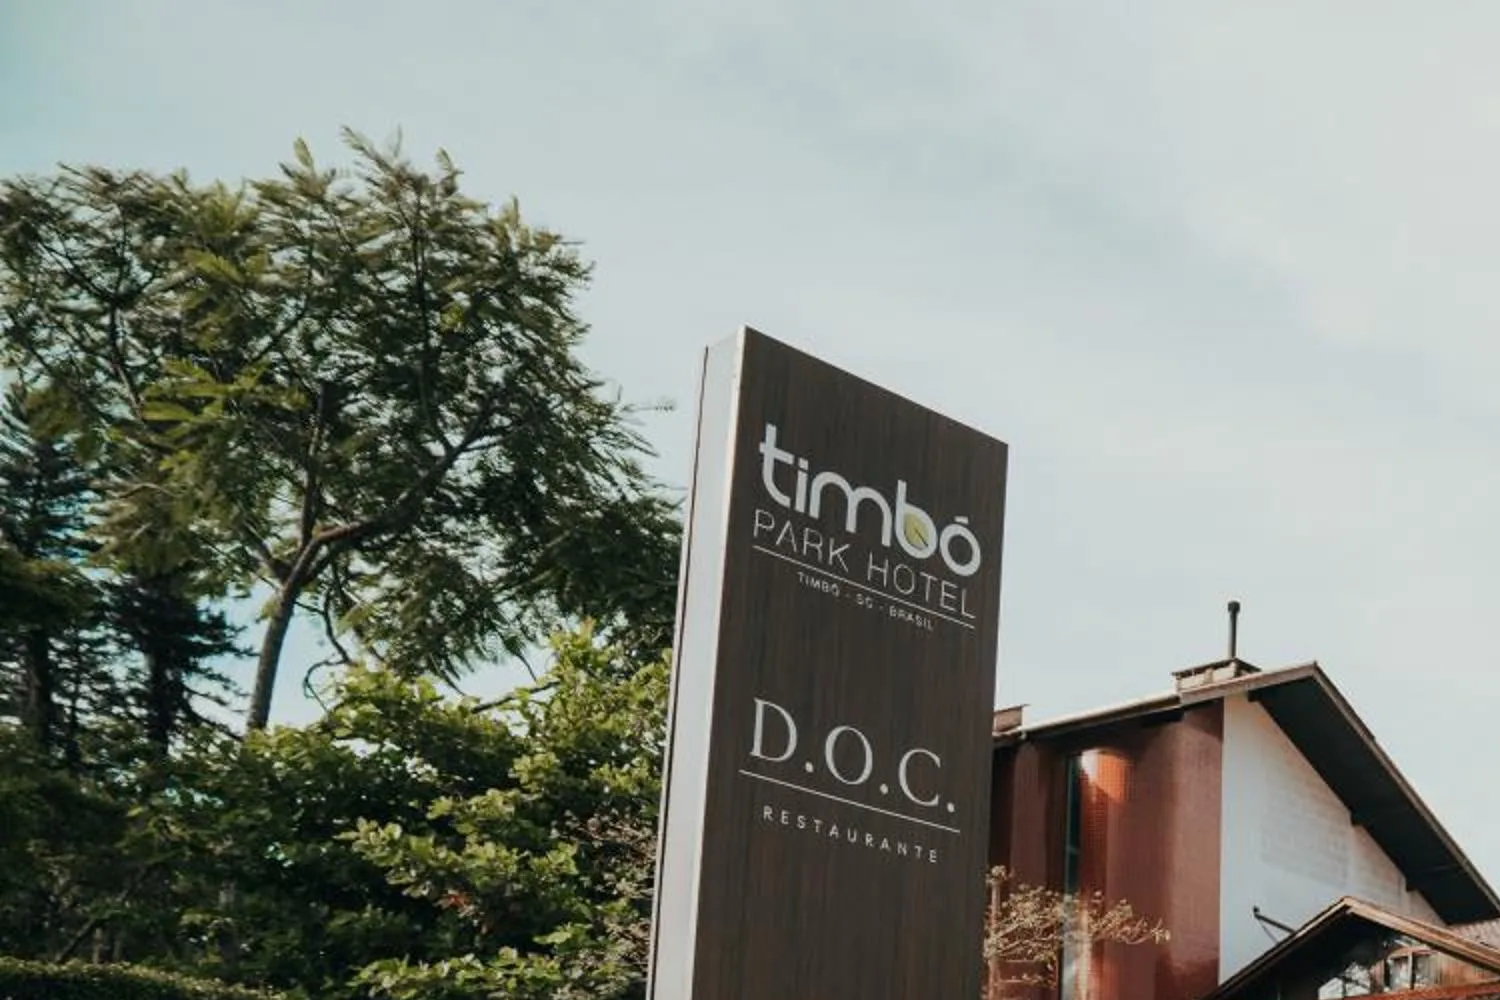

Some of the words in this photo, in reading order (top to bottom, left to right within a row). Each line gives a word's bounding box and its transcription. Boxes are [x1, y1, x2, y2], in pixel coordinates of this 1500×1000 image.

[753, 508, 850, 572] PARK
[867, 552, 976, 619] HOTEL
[856, 593, 873, 609] SC
[889, 605, 933, 631] BRASIL
[750, 697, 955, 813] D.O.C.
[763, 805, 937, 863] RESTAURANTE
